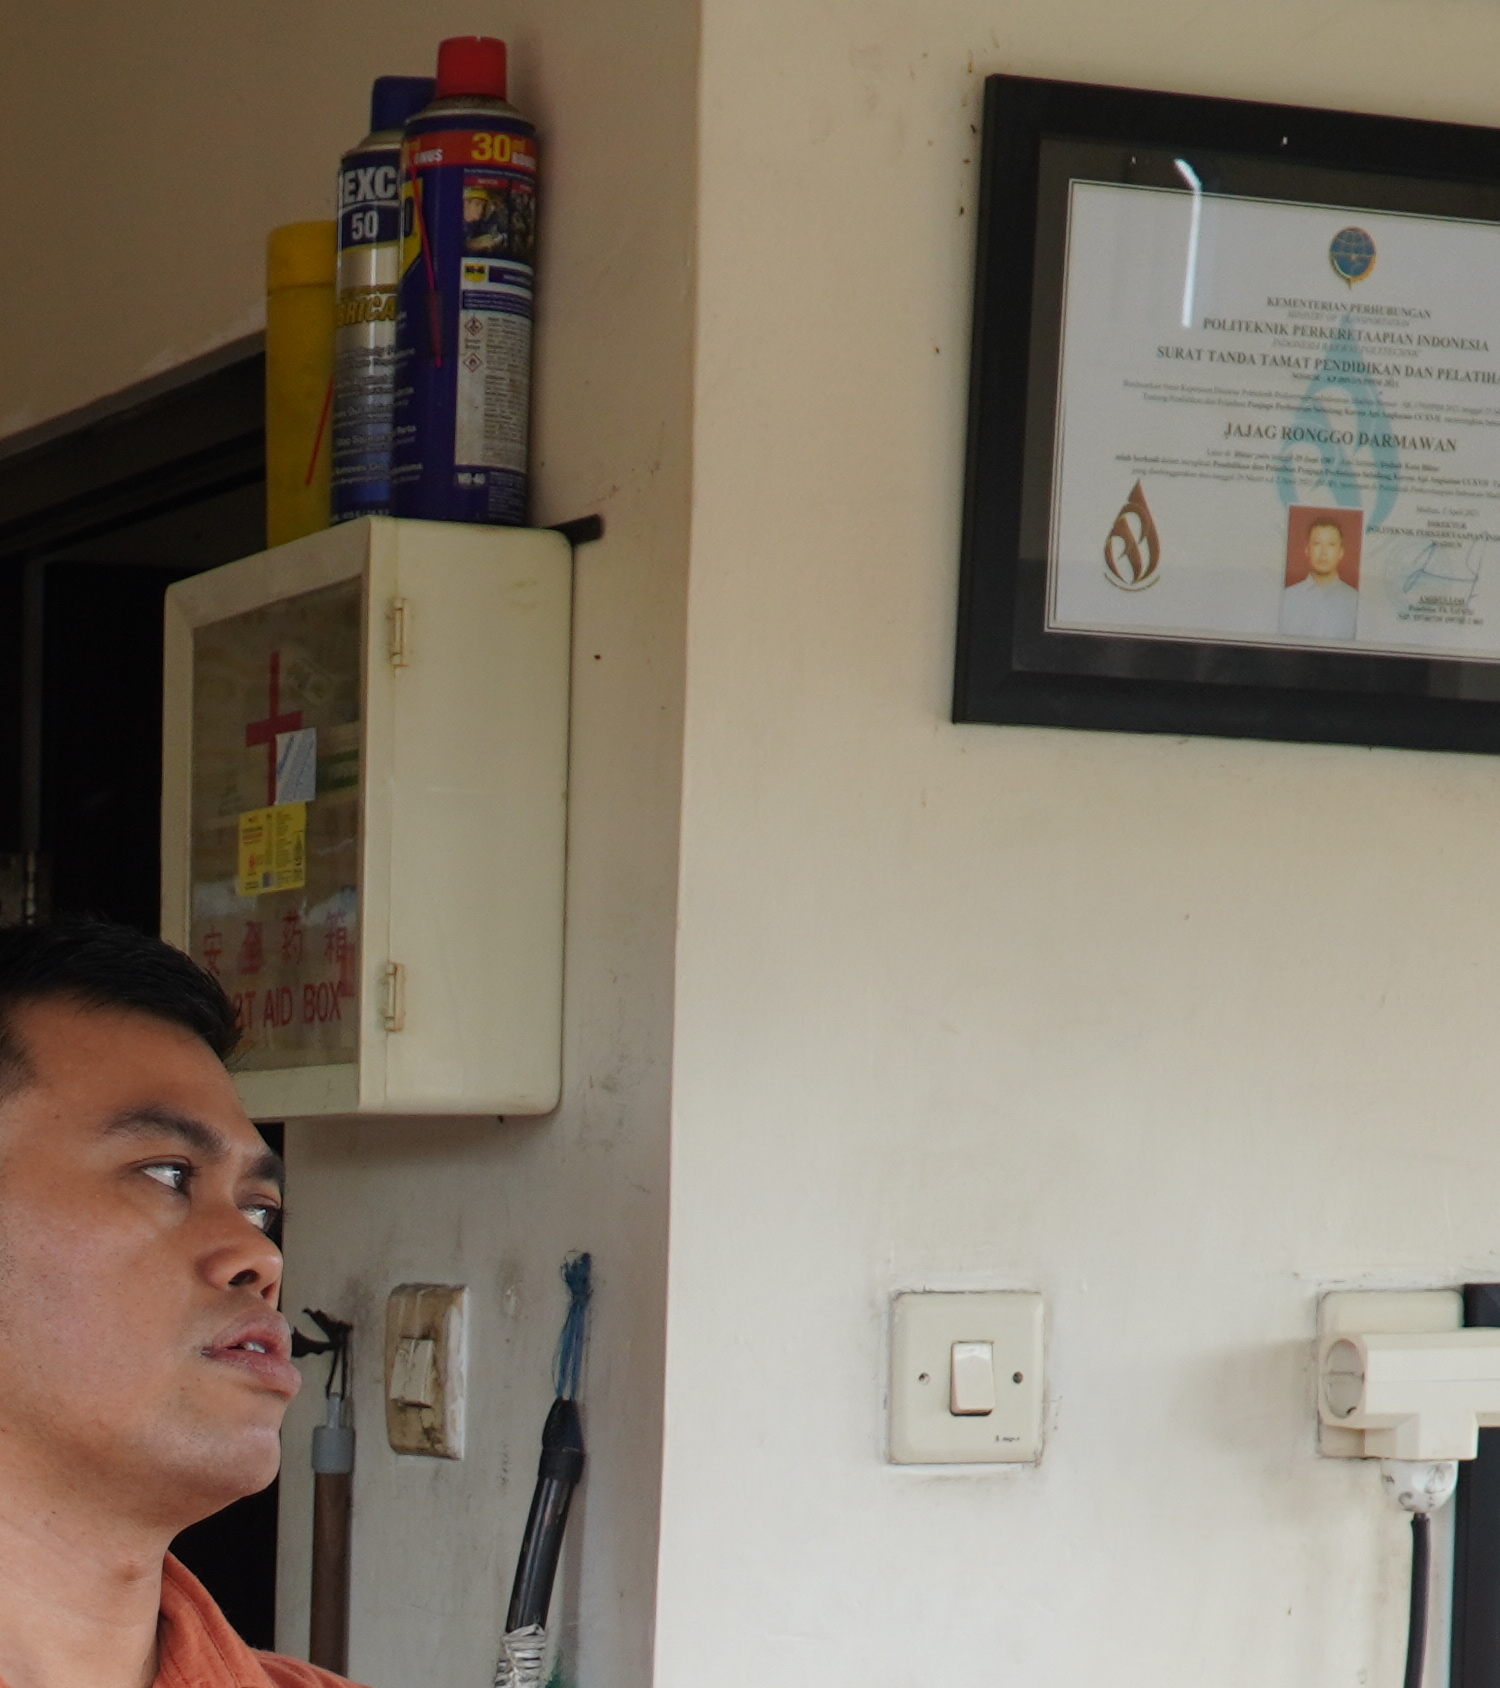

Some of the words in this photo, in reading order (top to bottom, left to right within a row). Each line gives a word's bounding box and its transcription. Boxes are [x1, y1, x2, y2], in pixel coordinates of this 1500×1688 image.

[471, 132, 511, 162] 30
[351, 210, 379, 240] 50
[1266, 296, 1348, 312] KEMENTERIAN
[1349, 303, 1432, 319] PERHUBUNGAN
[1202, 316, 1289, 336] POLITEKNIK
[1292, 323, 1413, 346] PERKERETAAPIAN
[1416, 332, 1489, 351] INDONESIA
[1156, 344, 1203, 362] SURAT
[1207, 348, 1257, 366] TANDA
[1260, 352, 1312, 371] TAMAT
[1314, 356, 1401, 378] PENDIDIKAN
[1404, 364, 1434, 381] DAN
[1223, 421, 1277, 440] JAJAG
[1281, 426, 1354, 446] RONGGO
[1358, 431, 1457, 452] DARMAWAN
[263, 985, 294, 1029] AID
[303, 981, 342, 1025] BOX
